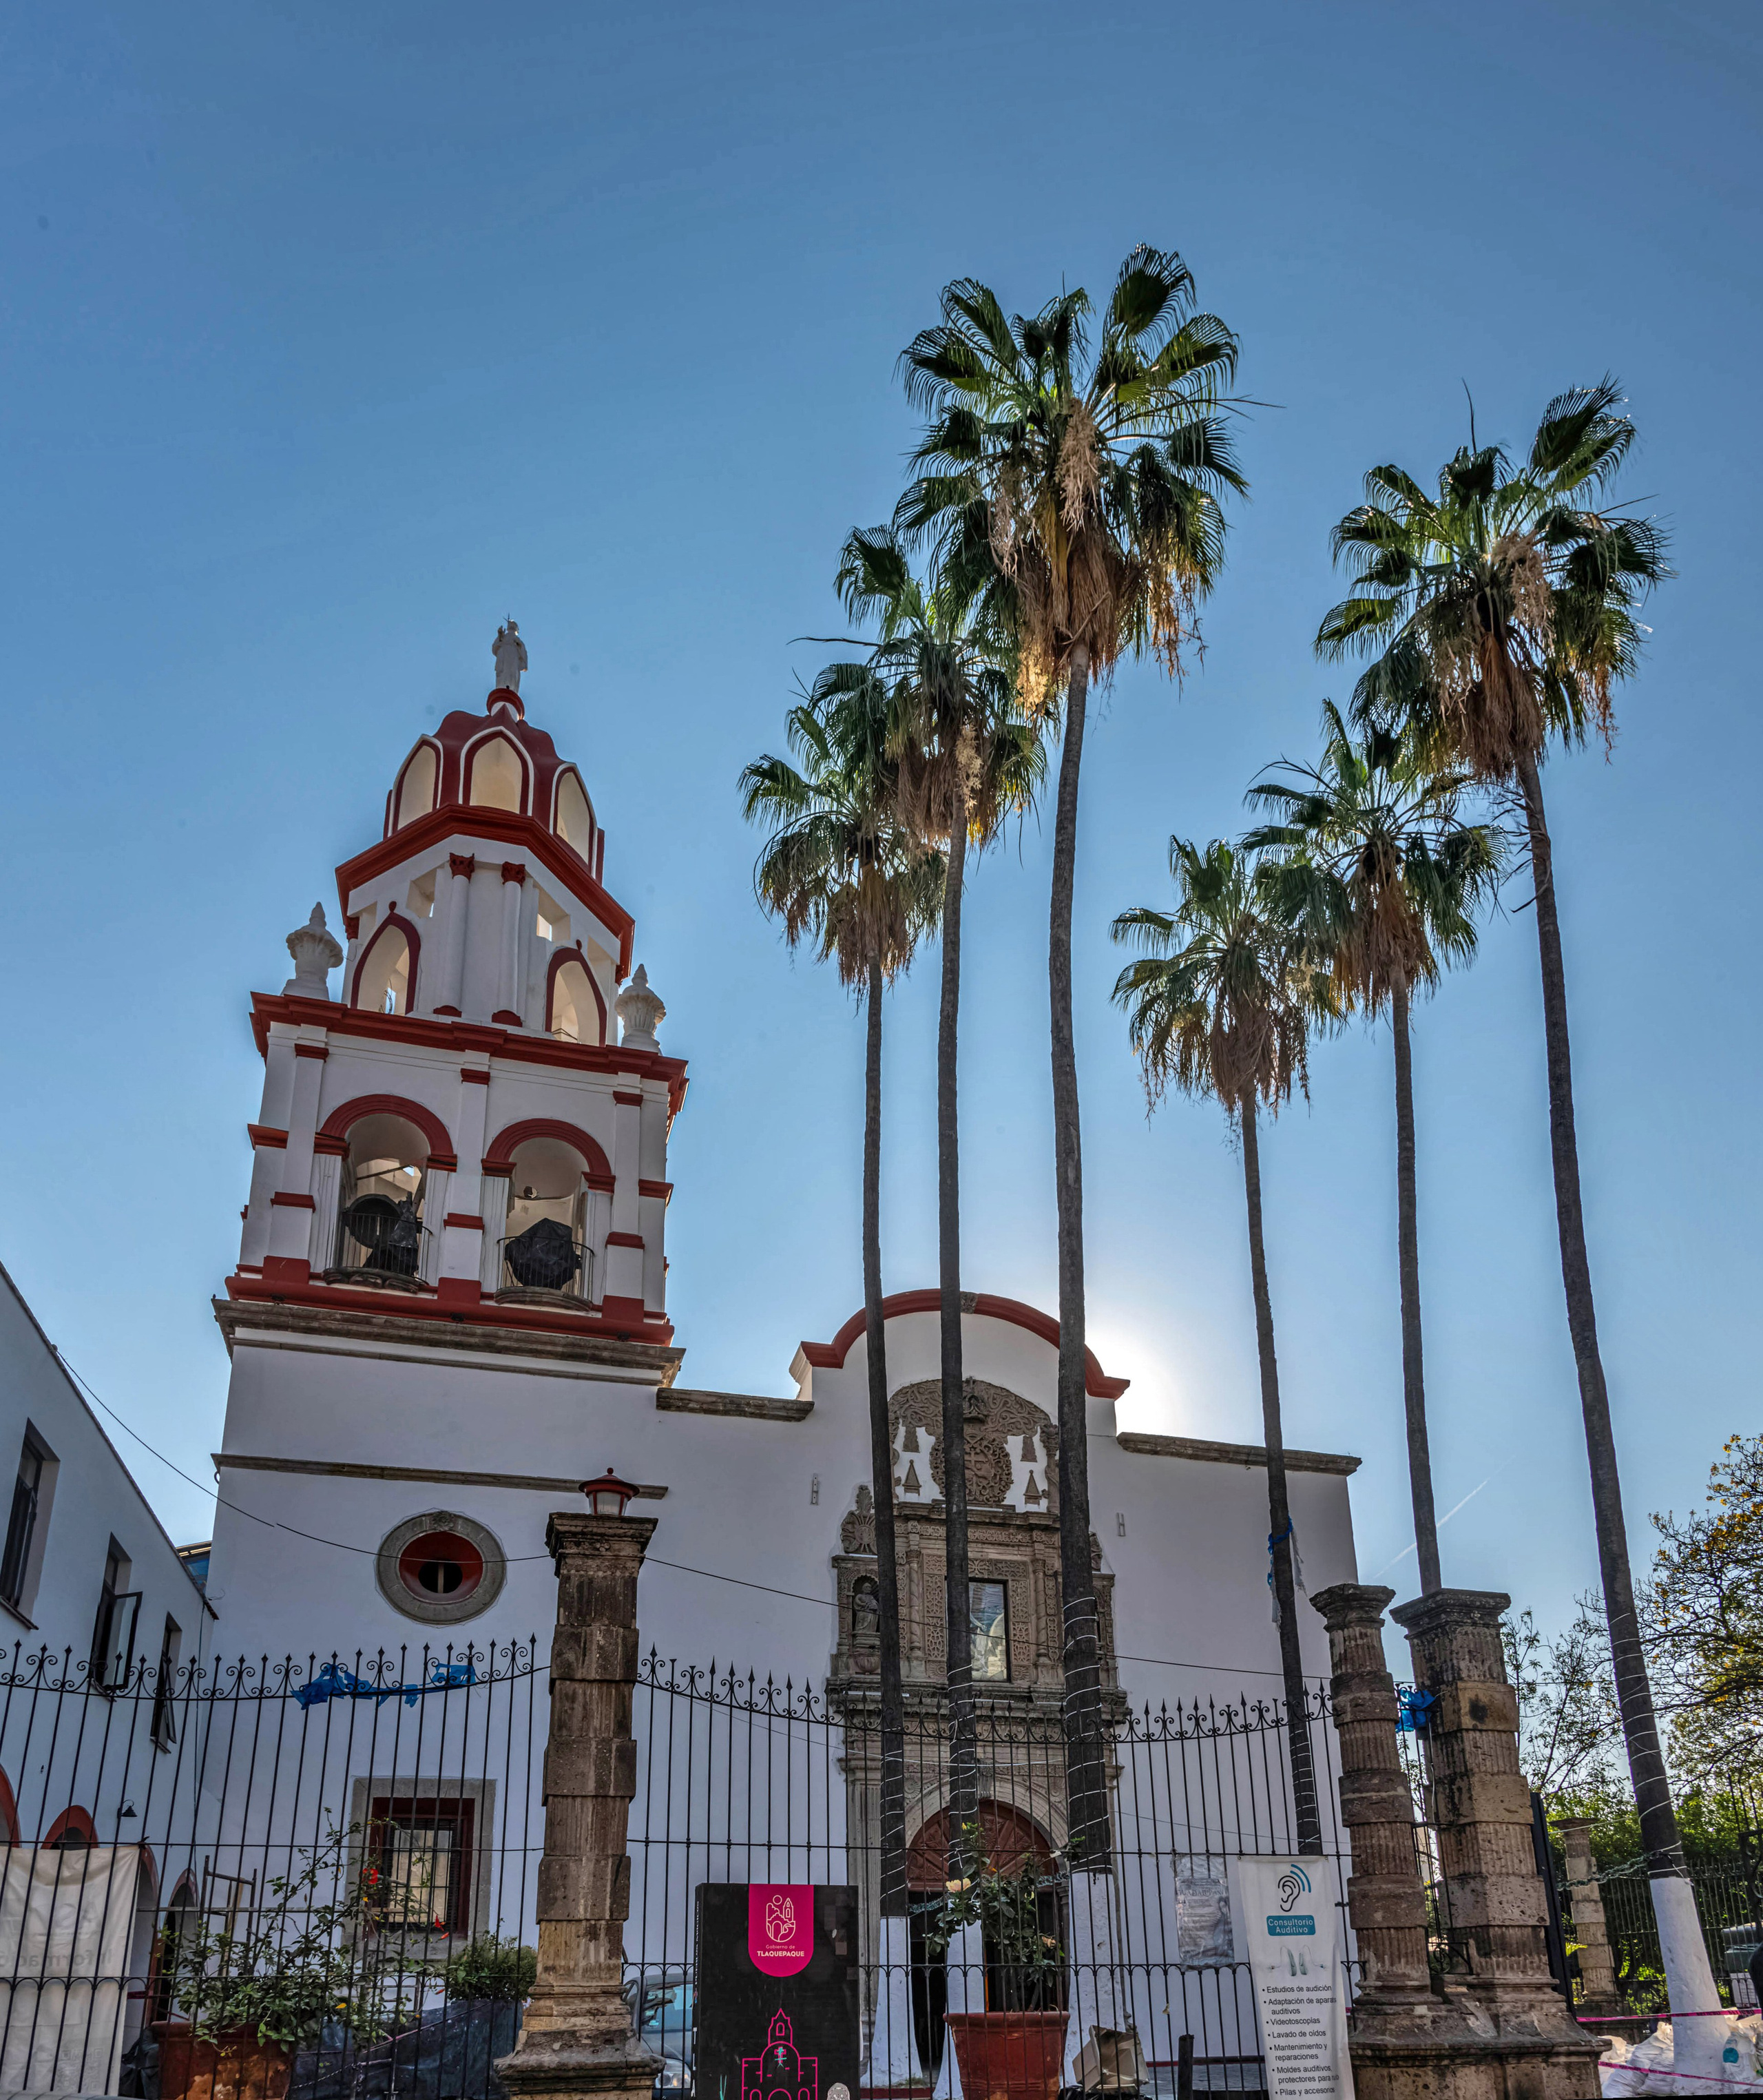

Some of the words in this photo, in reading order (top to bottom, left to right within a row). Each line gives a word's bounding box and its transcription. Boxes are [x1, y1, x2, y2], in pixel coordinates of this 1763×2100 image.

[1269, 1997, 1304, 2006] Adaptación
[1273, 2043, 1322, 2051] Mantenimiento
[1275, 2053, 1319, 2062] reparaciones
[1278, 2076, 1316, 2085] protectores
[1304, 2086, 1335, 2094] accesorios
